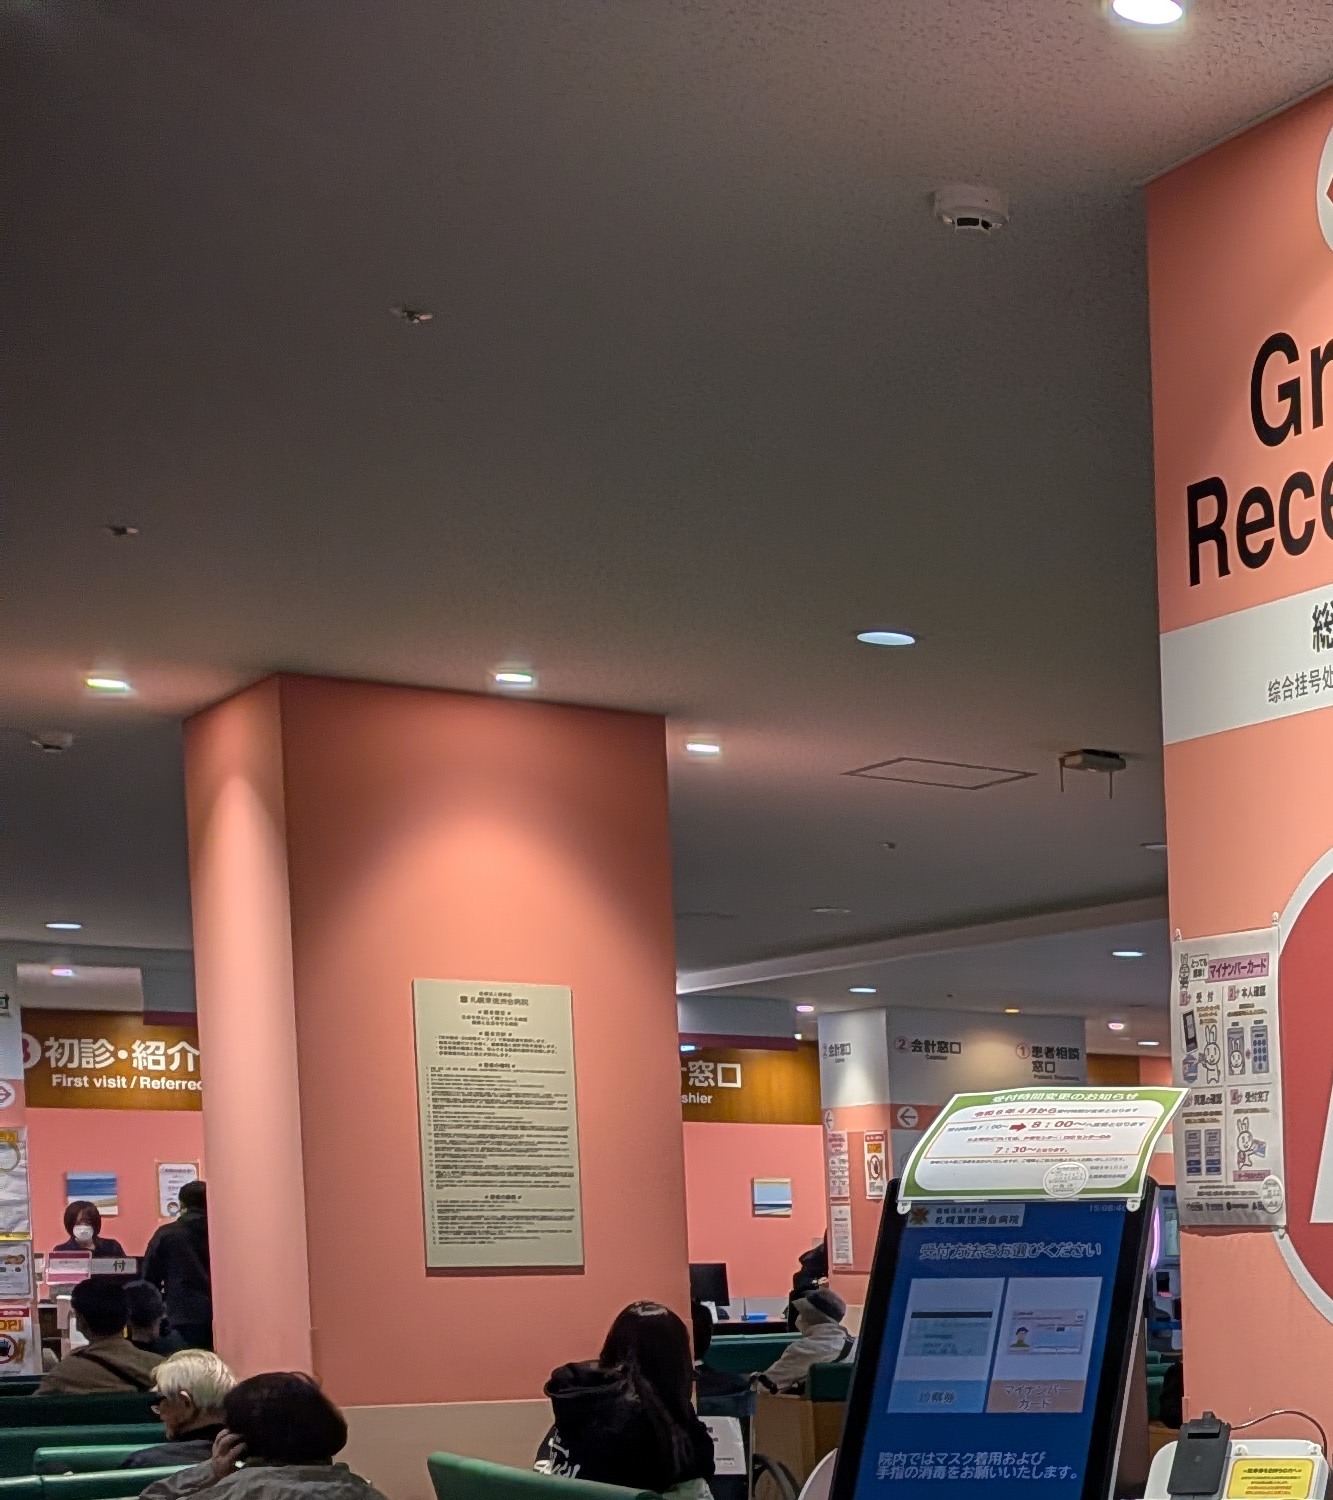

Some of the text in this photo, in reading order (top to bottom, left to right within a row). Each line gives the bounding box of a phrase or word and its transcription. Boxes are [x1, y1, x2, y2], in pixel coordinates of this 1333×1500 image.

[1209, 957, 1267, 979] マイナンバーカード
[45, 1036, 200, 1072] 初診・紹介
[911, 1039, 961, 1054] 会計窓口
[1032, 1060, 1056, 1073] 窓口
[52, 1074, 89, 1087] First
[93, 1076, 127, 1088] visit
[681, 1060, 742, 1089] 窓口
[681, 1092, 713, 1104] shier
[991, 1092, 1140, 1104] 受付時間変更のお知らせ
[920, 1243, 1102, 1260] 受付方法をお選びください
[1004, 1384, 1070, 1397] マイナンバー
[1018, 1398, 1053, 1410] カード
[878, 1451, 1046, 1467] 院内ではマスク着用および
[876, 1465, 1079, 1481] 手指の消毒をお願いいたします。
